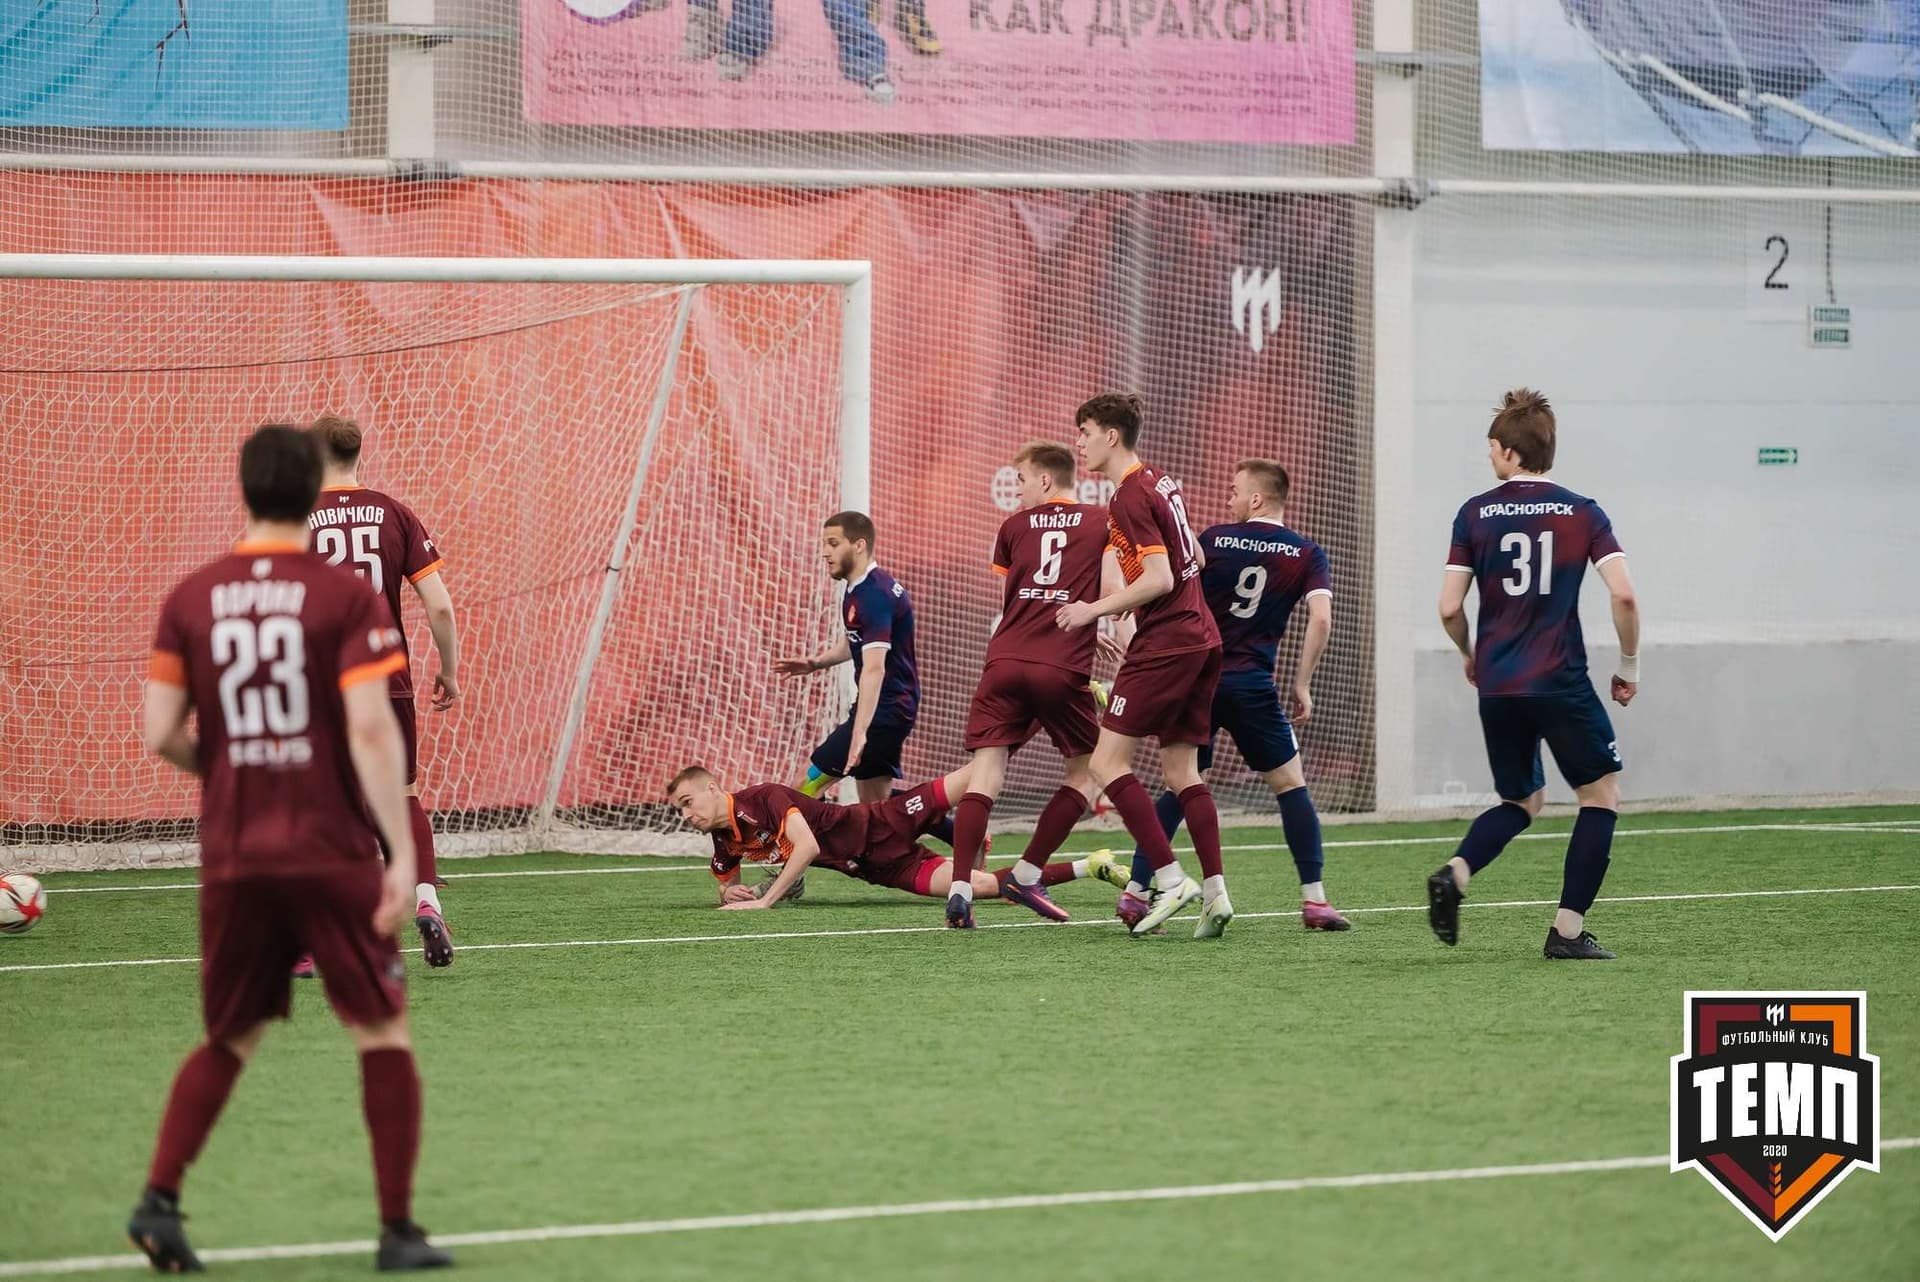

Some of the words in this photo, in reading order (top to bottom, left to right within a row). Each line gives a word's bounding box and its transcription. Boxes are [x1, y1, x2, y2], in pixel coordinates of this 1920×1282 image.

[970, 0, 1072, 34] КАК
[1764, 235, 1790, 289] 2
[307, 505, 385, 530] НОВИЧКОВ
[1029, 512, 1083, 529] КНЯЗЕВ
[1479, 502, 1575, 519] КРАСНОЯРСК
[317, 525, 384, 595] 25
[1032, 530, 1067, 586] 6
[1214, 536, 1301, 557] КРАСНОЯРСК
[1500, 531, 1554, 597] 31
[1018, 588, 1071, 600] SEUS
[1229, 565, 1268, 619] 9
[211, 617, 309, 738] 23
[1110, 694, 1127, 717] 18
